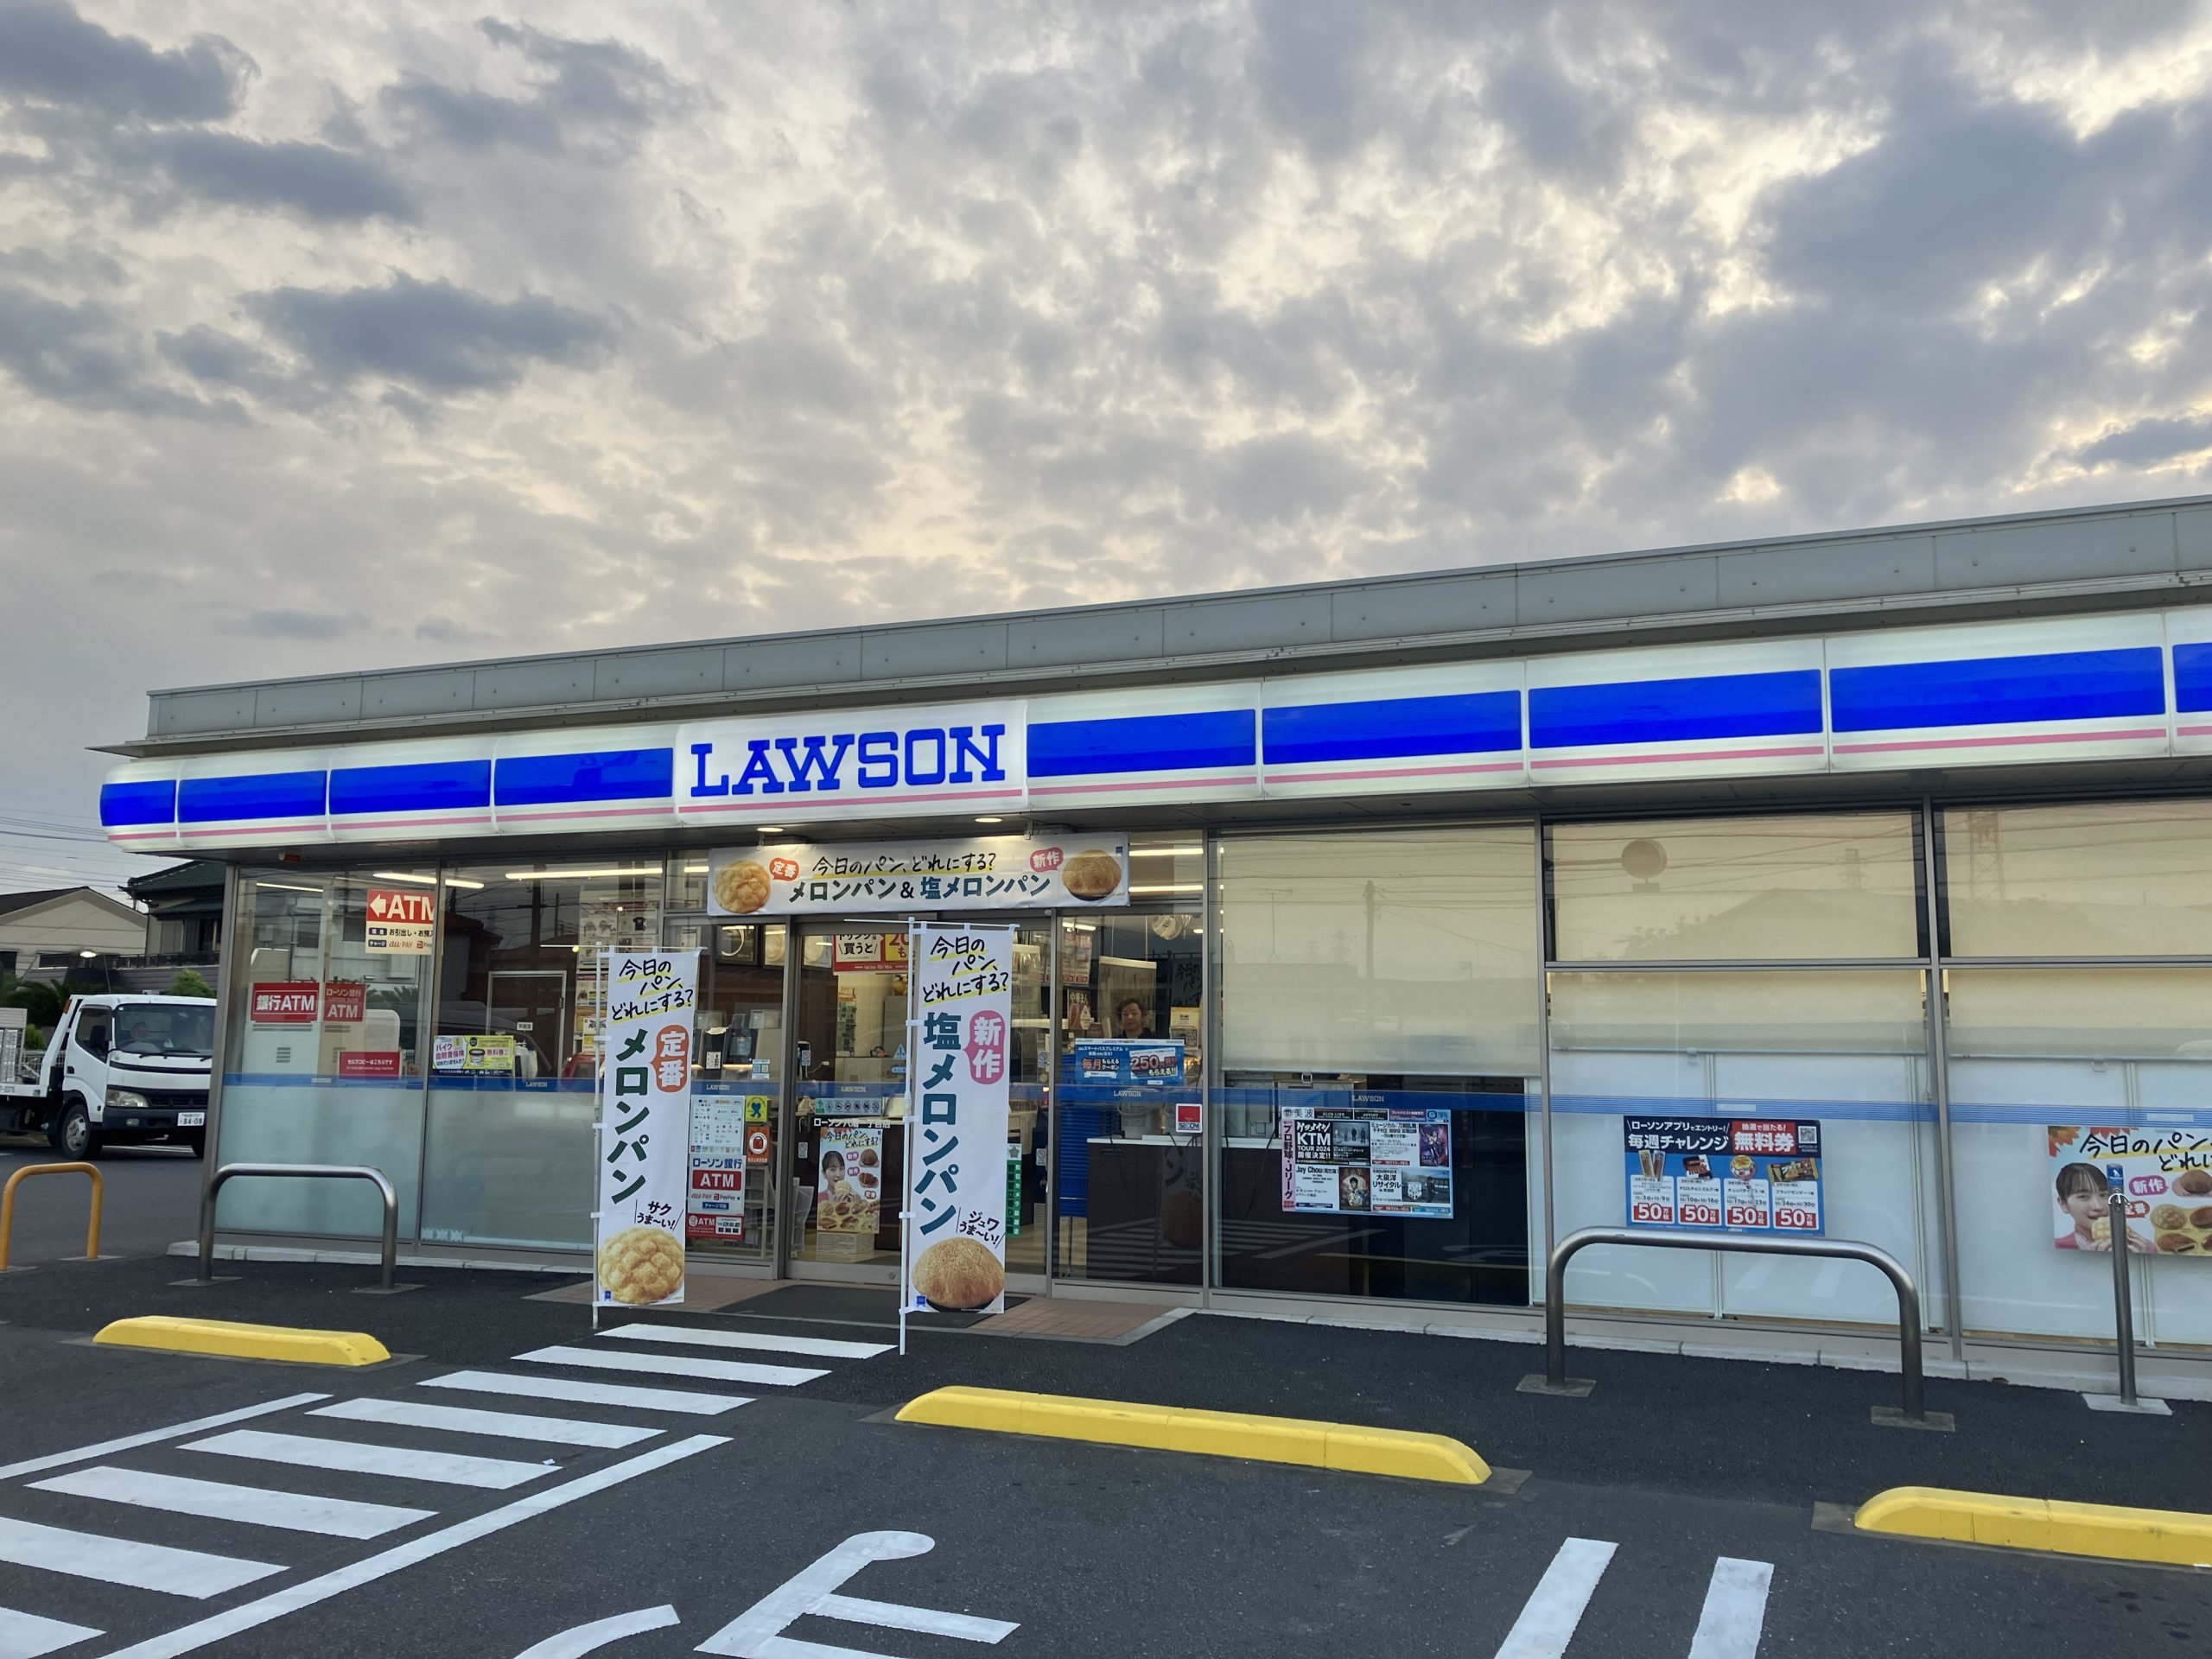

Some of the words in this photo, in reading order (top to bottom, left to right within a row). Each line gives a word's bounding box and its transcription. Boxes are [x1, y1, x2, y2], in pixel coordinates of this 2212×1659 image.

[691, 724, 1005, 797] LAWSON
[1033, 851, 1060, 868] 新作
[773, 861, 797, 877] 定番
[843, 943, 873, 955] 買うと
[931, 935, 985, 959] 今日の
[619, 958, 671, 980] 今日の
[326, 988, 362, 997] ローソン銀行
[923, 972, 1009, 1002] どれにする?
[256, 995, 315, 1012] 銀行ATM
[327, 1004, 359, 1018] ATM
[611, 989, 694, 1021] どれにする?
[973, 1017, 1002, 1079] 新作
[658, 1031, 686, 1087] 定番
[607, 1028, 650, 1205] メロンパン
[1294, 1108, 1313, 1118] 美波
[914, 1012, 962, 1236] 塩メロンパン
[1631, 1121, 1726, 1133] ローソンアプリでエントリー!
[1741, 1122, 1787, 1132] 抽選で当たる!
[1298, 1133, 1331, 1146] KTM
[1628, 1134, 1729, 1151] 毎週チャレンジ
[1734, 1131, 1795, 1153] 無料券
[693, 1158, 743, 1169] ローソン銀行
[700, 1173, 734, 1188] ATM
[2133, 1178, 2164, 1194] 新作
[647, 1200, 672, 1216] サク
[698, 1217, 715, 1226] ATM
[968, 1211, 1000, 1231] ジュワ
